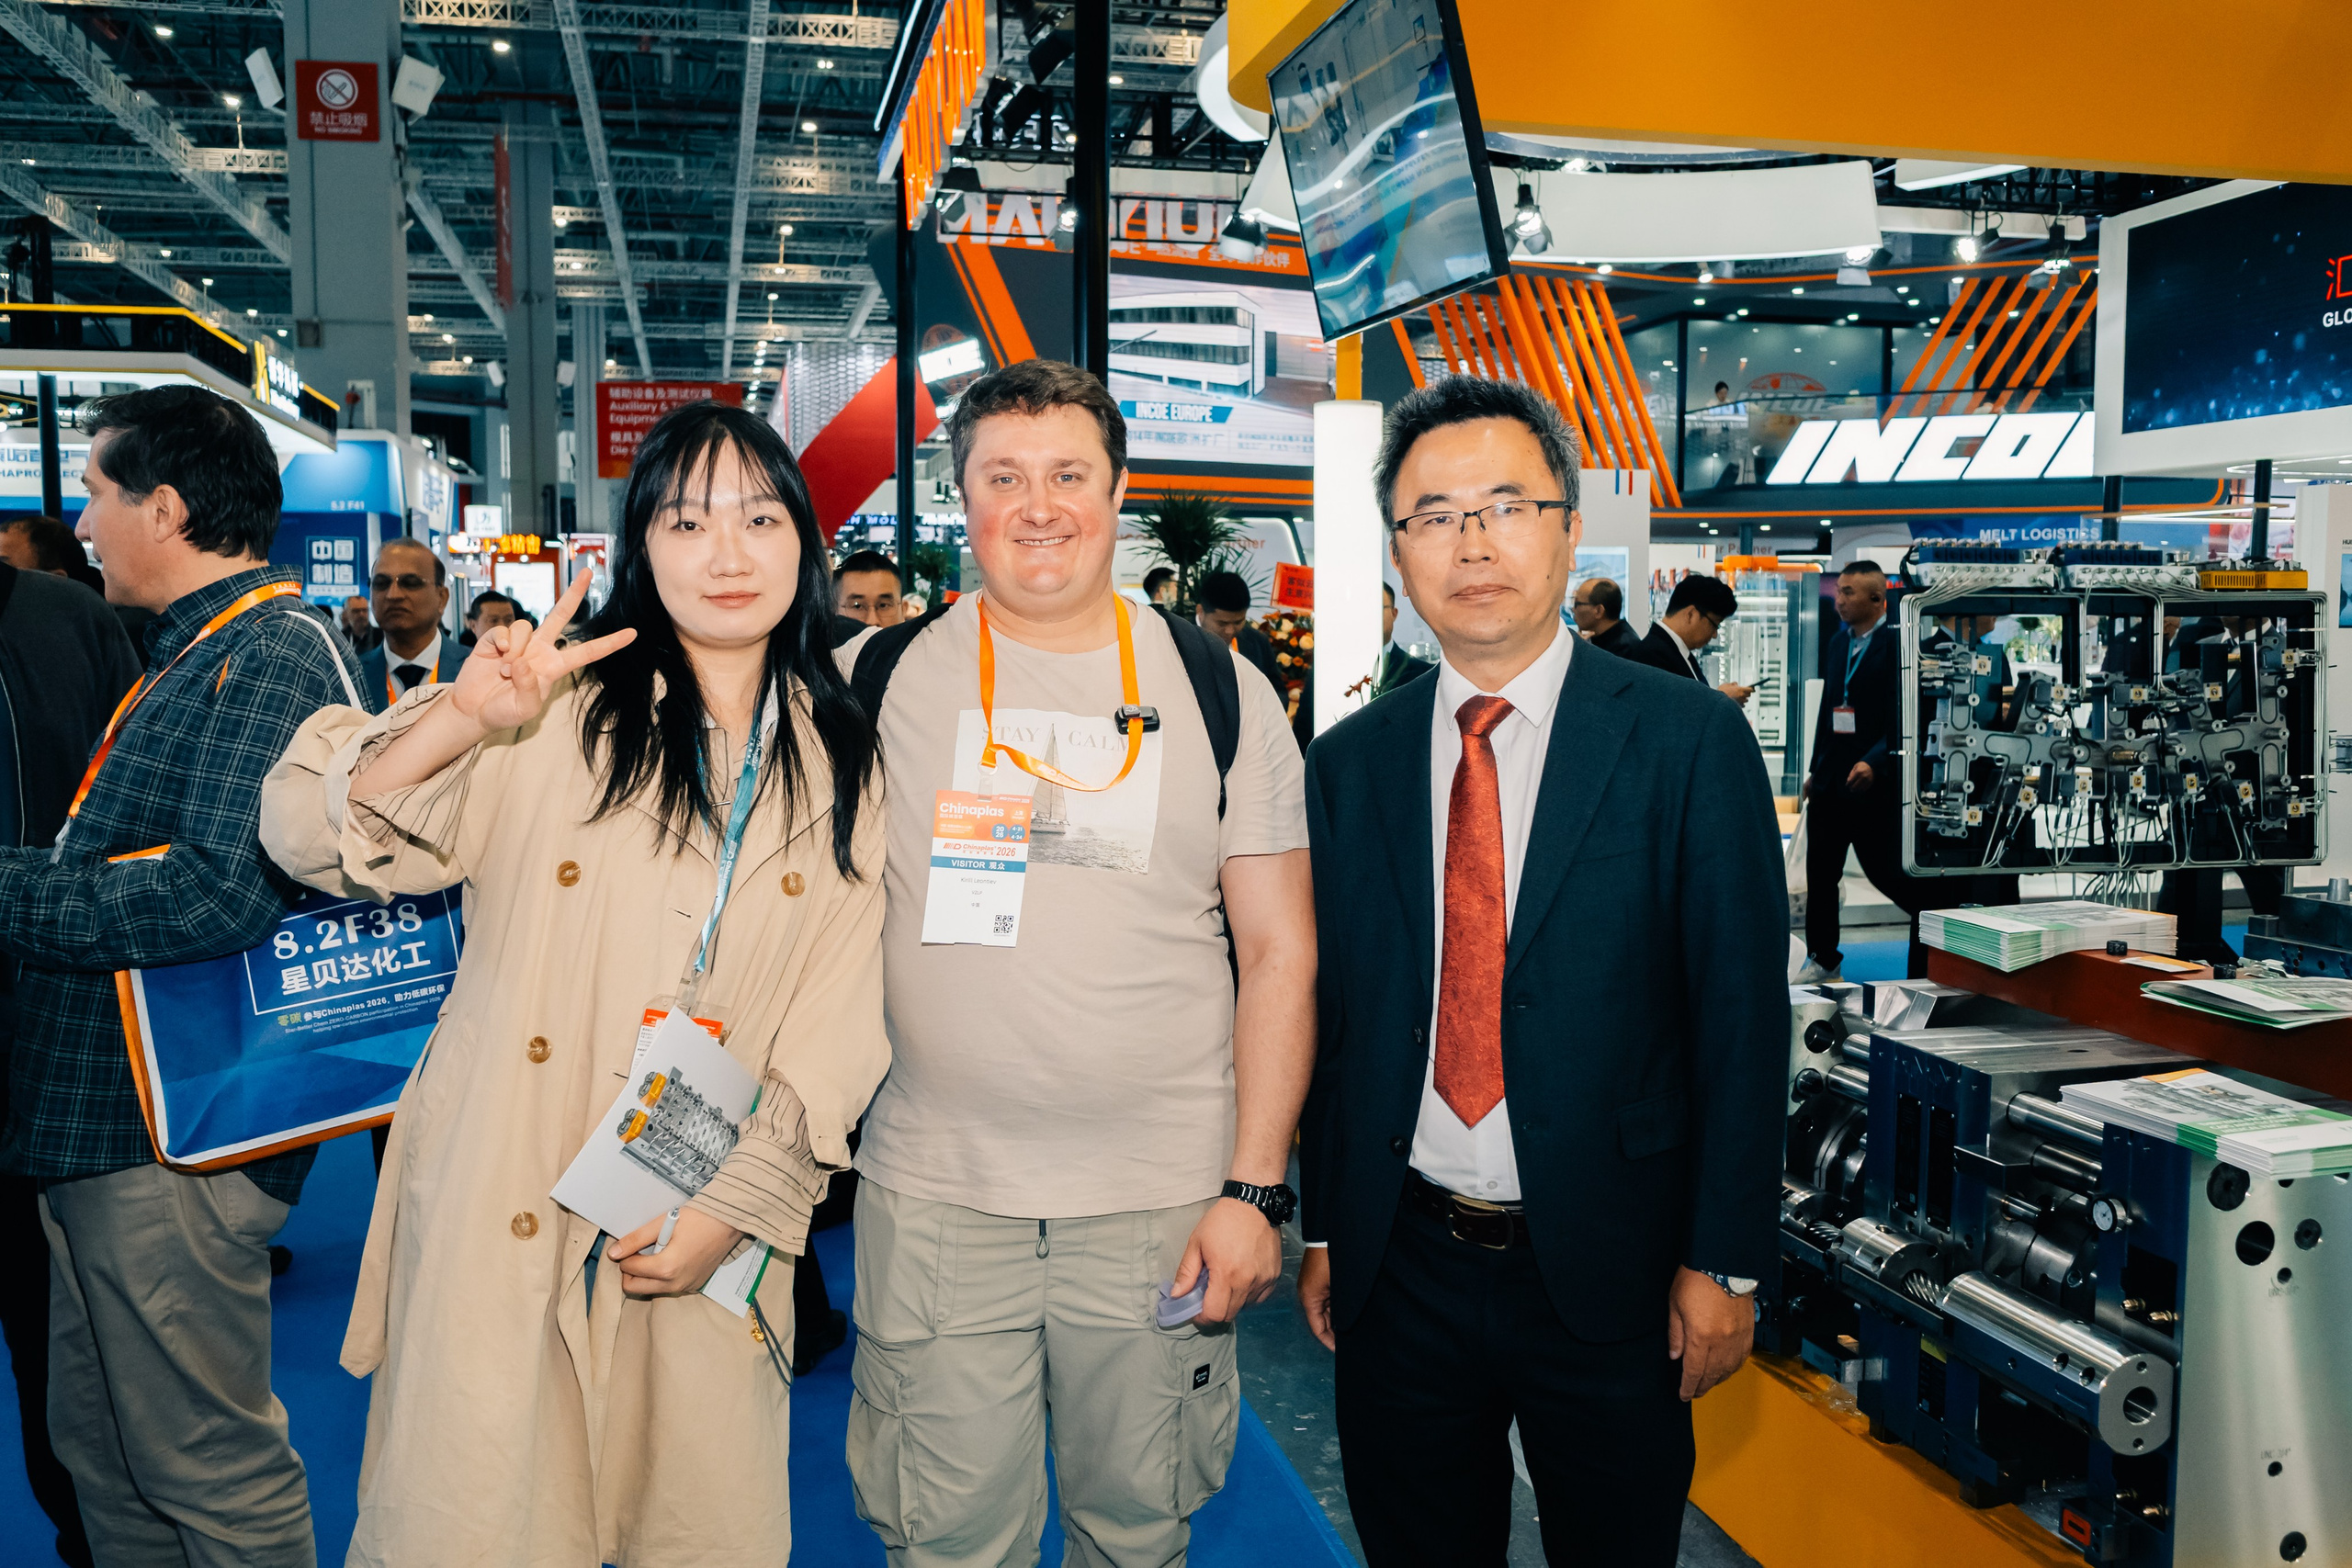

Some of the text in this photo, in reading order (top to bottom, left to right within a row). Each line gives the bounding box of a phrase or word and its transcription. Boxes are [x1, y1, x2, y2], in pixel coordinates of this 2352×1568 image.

[311, 112, 367, 128] 禁止吸烟
[609, 388, 712, 399] 辅助设备及测试仪器
[610, 400, 657, 412] Auxiliary
[1136, 401, 1214, 423] INCOE EUROPE
[610, 414, 660, 425] Equipme
[610, 445, 628, 456] Die
[1979, 527, 2100, 542] MELT LOGISTICS
[939, 802, 1004, 818] Chinaplas
[996, 846, 1016, 857] 2026
[951, 859, 1005, 870] VISITOR 观众
[273, 903, 423, 960] 8.2F38
[281, 941, 431, 996] 星贝达化工
[277, 1011, 301, 1026] 零碳
